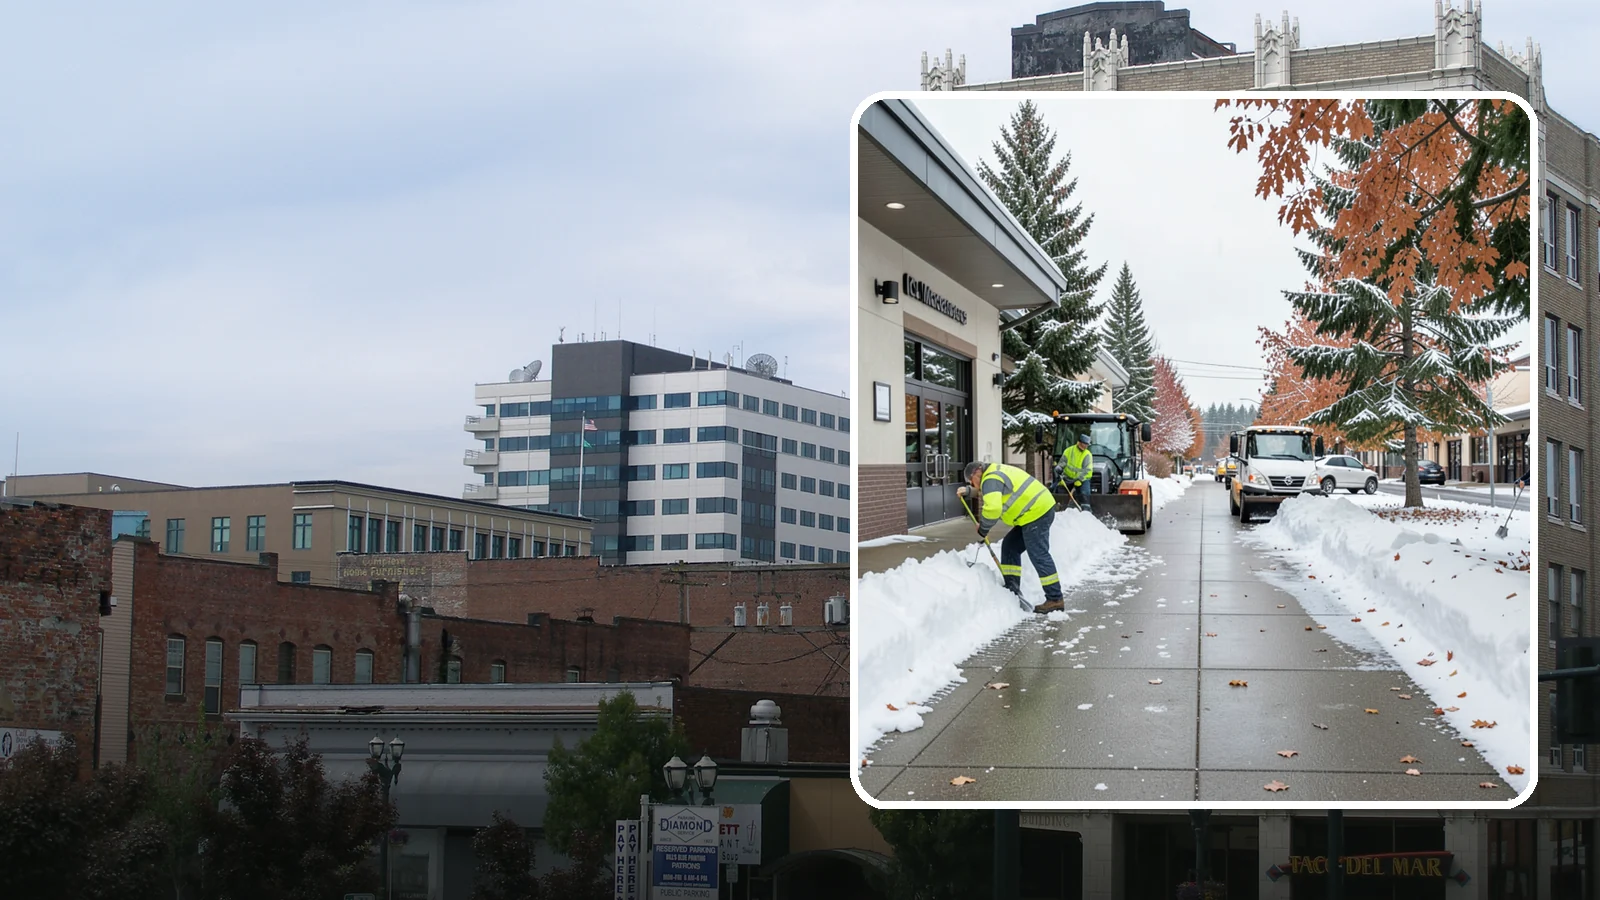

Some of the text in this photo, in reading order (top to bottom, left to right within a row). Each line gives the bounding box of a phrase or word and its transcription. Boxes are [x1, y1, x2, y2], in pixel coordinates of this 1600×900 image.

[660, 818, 713, 832] DIAMOND
[1021, 815, 1070, 828] BUILDING
[655, 845, 716, 854] RESERVED PARKING
[616, 825, 625, 893] PAY HERE
[628, 824, 637, 893] PAY HERE
[722, 851, 739, 862] Soup
[671, 862, 701, 870] PATRONS
[1289, 855, 1443, 877] TAC DEL MAR
[660, 889, 710, 898] PUBLIC PARKING
